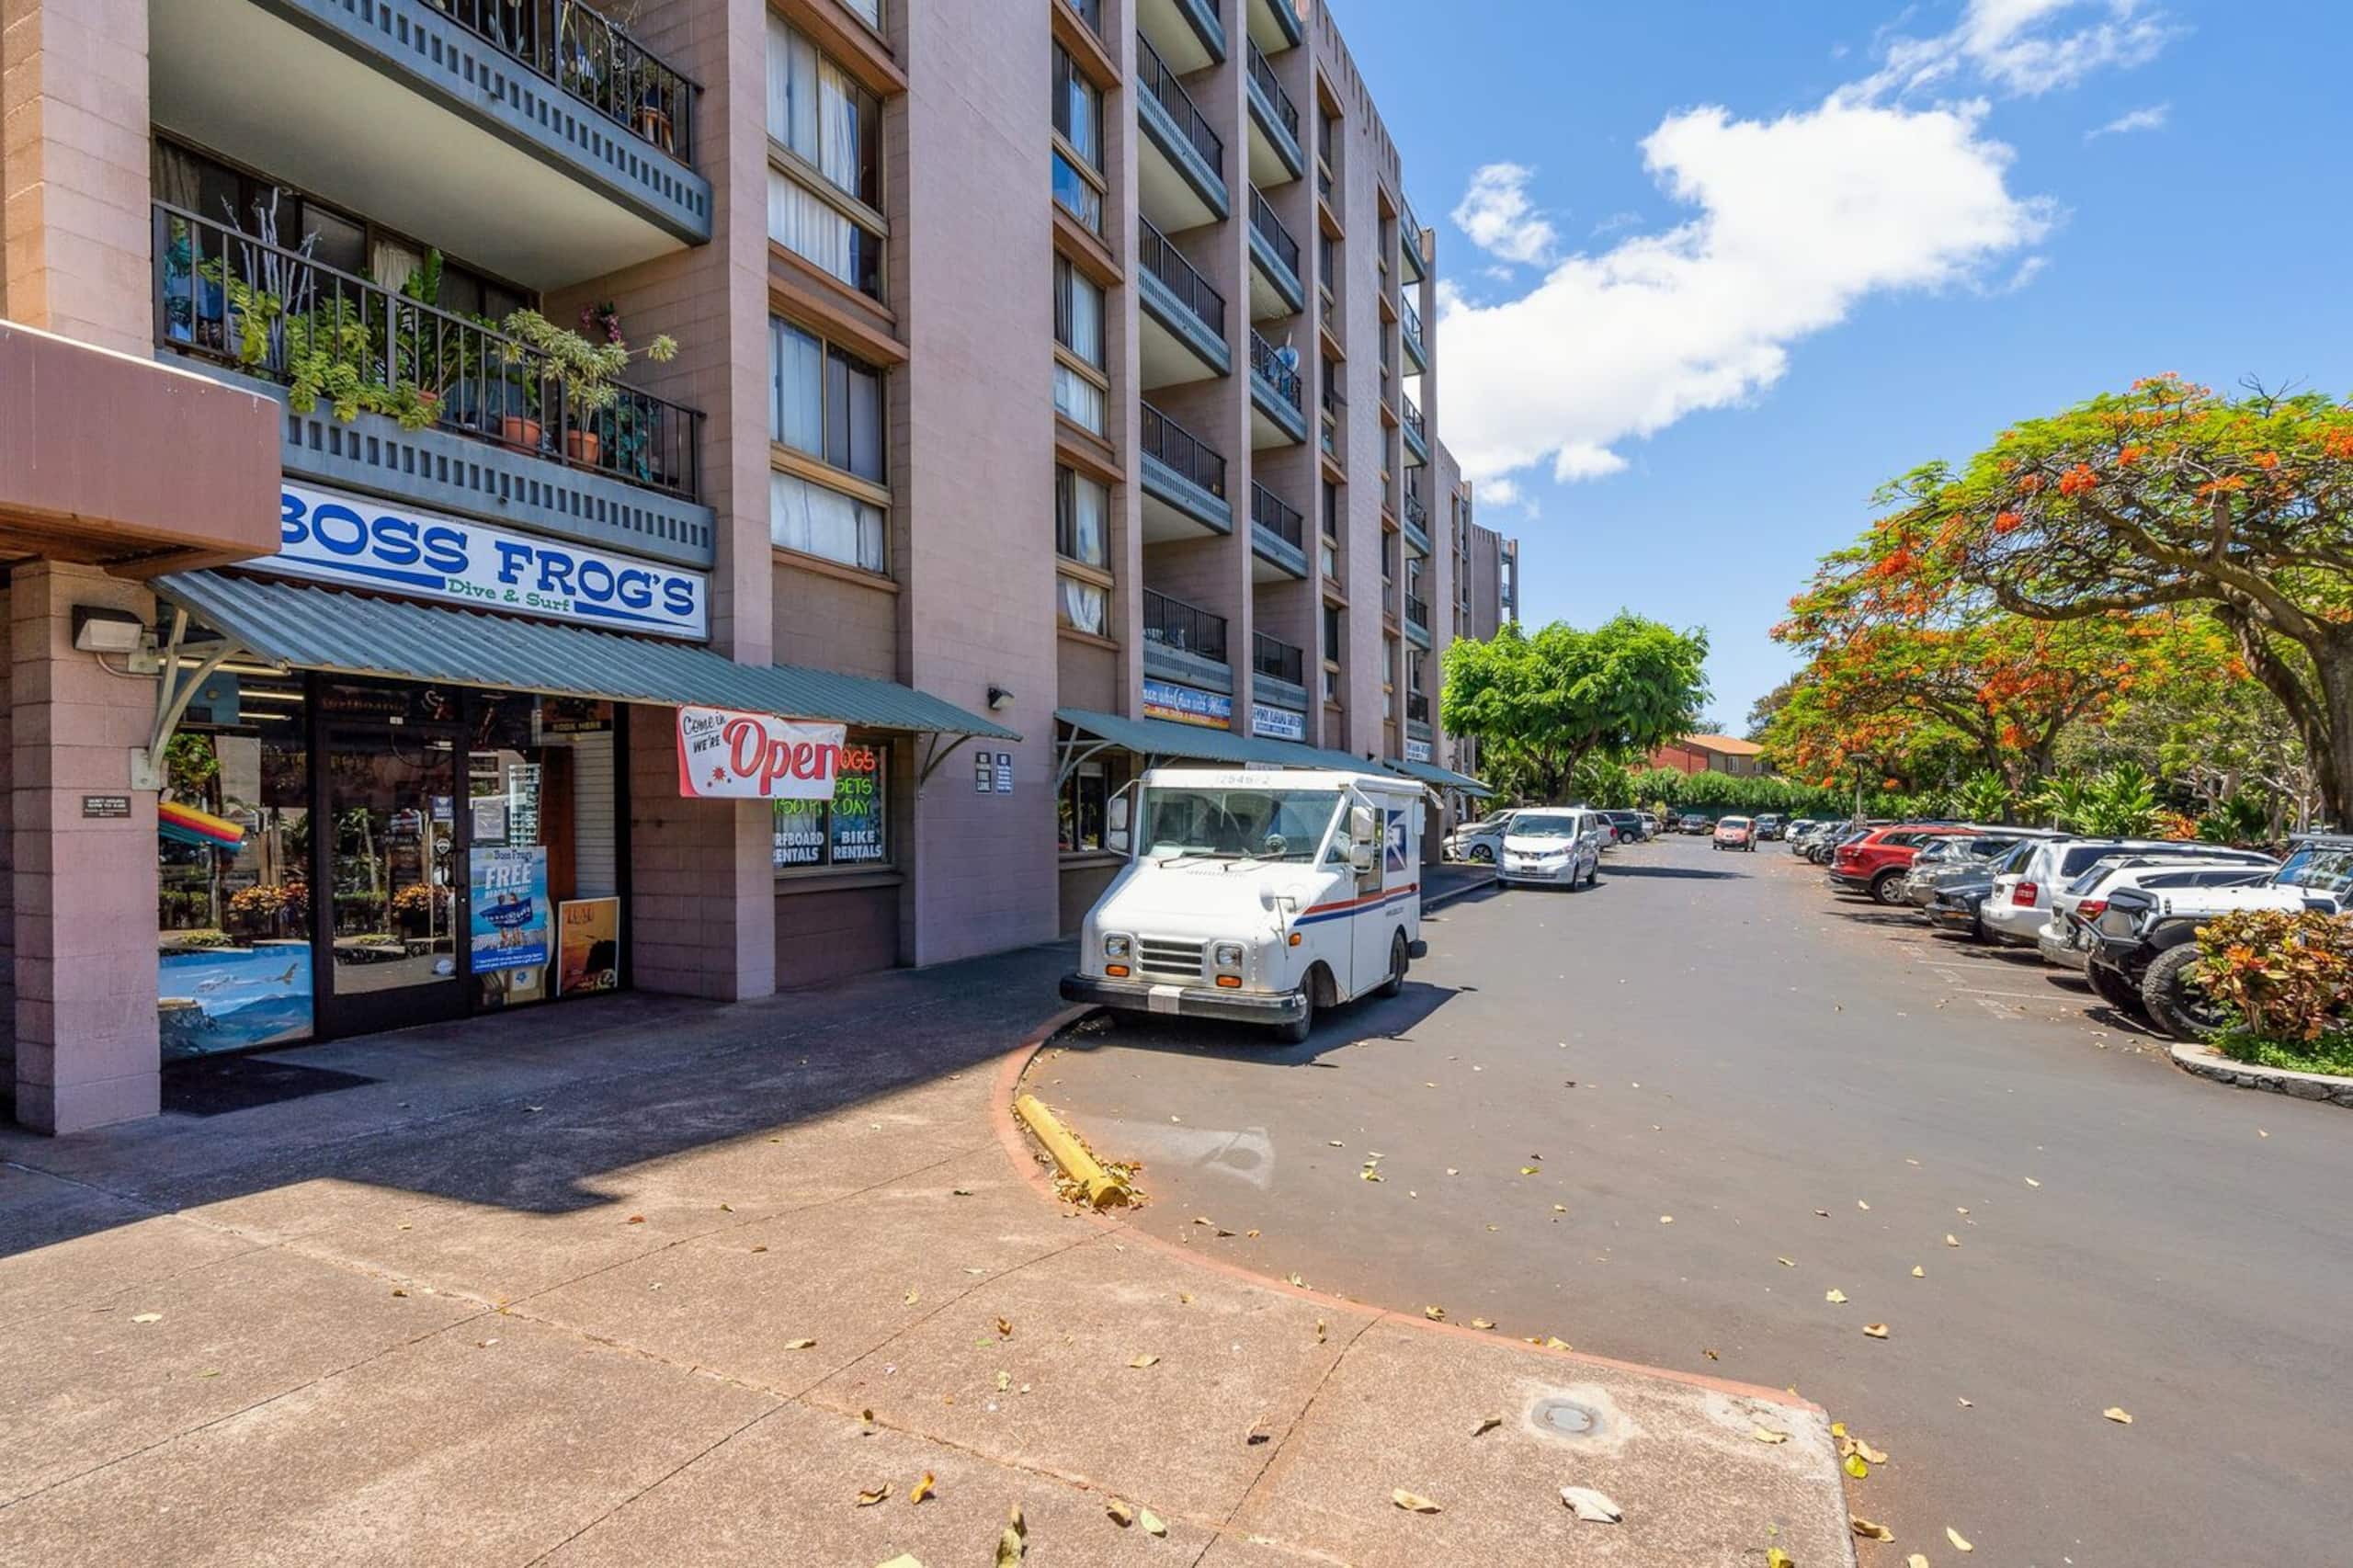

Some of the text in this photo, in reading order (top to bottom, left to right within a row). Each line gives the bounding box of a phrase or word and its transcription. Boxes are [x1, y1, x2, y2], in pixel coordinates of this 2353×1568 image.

[281, 493, 695, 617] BOSS FROG'S
[449, 579, 570, 612] Dive & Surf
[683, 711, 726, 735] Come in
[693, 735, 721, 754] WE'RE
[722, 717, 842, 796] Open
[841, 830, 875, 845] BIKE
[833, 845, 882, 860] RENTALS
[485, 863, 532, 890] FREE
